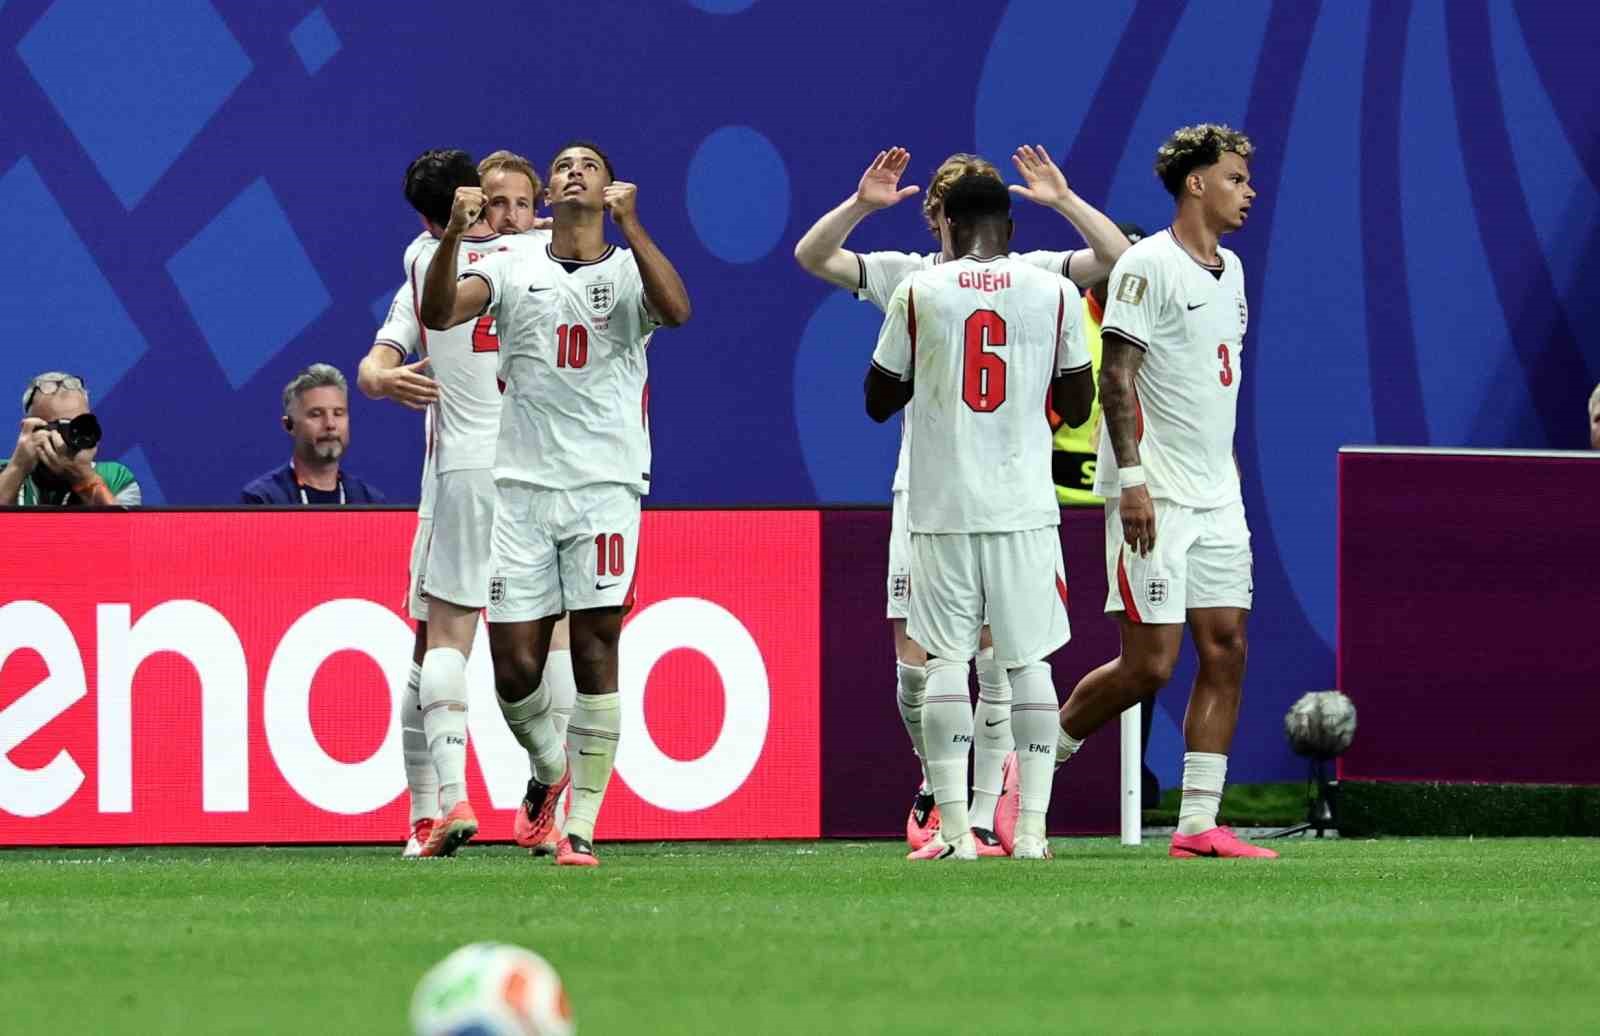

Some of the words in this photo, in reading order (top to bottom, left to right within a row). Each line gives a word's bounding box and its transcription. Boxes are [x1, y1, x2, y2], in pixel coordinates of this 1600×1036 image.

[958, 269, 1012, 292] GUÉHI
[556, 323, 589, 369] 10
[962, 308, 1007, 413] 6
[1216, 343, 1233, 387] 3
[594, 532, 625, 577] 10
[1029, 743, 1051, 754] ENG
